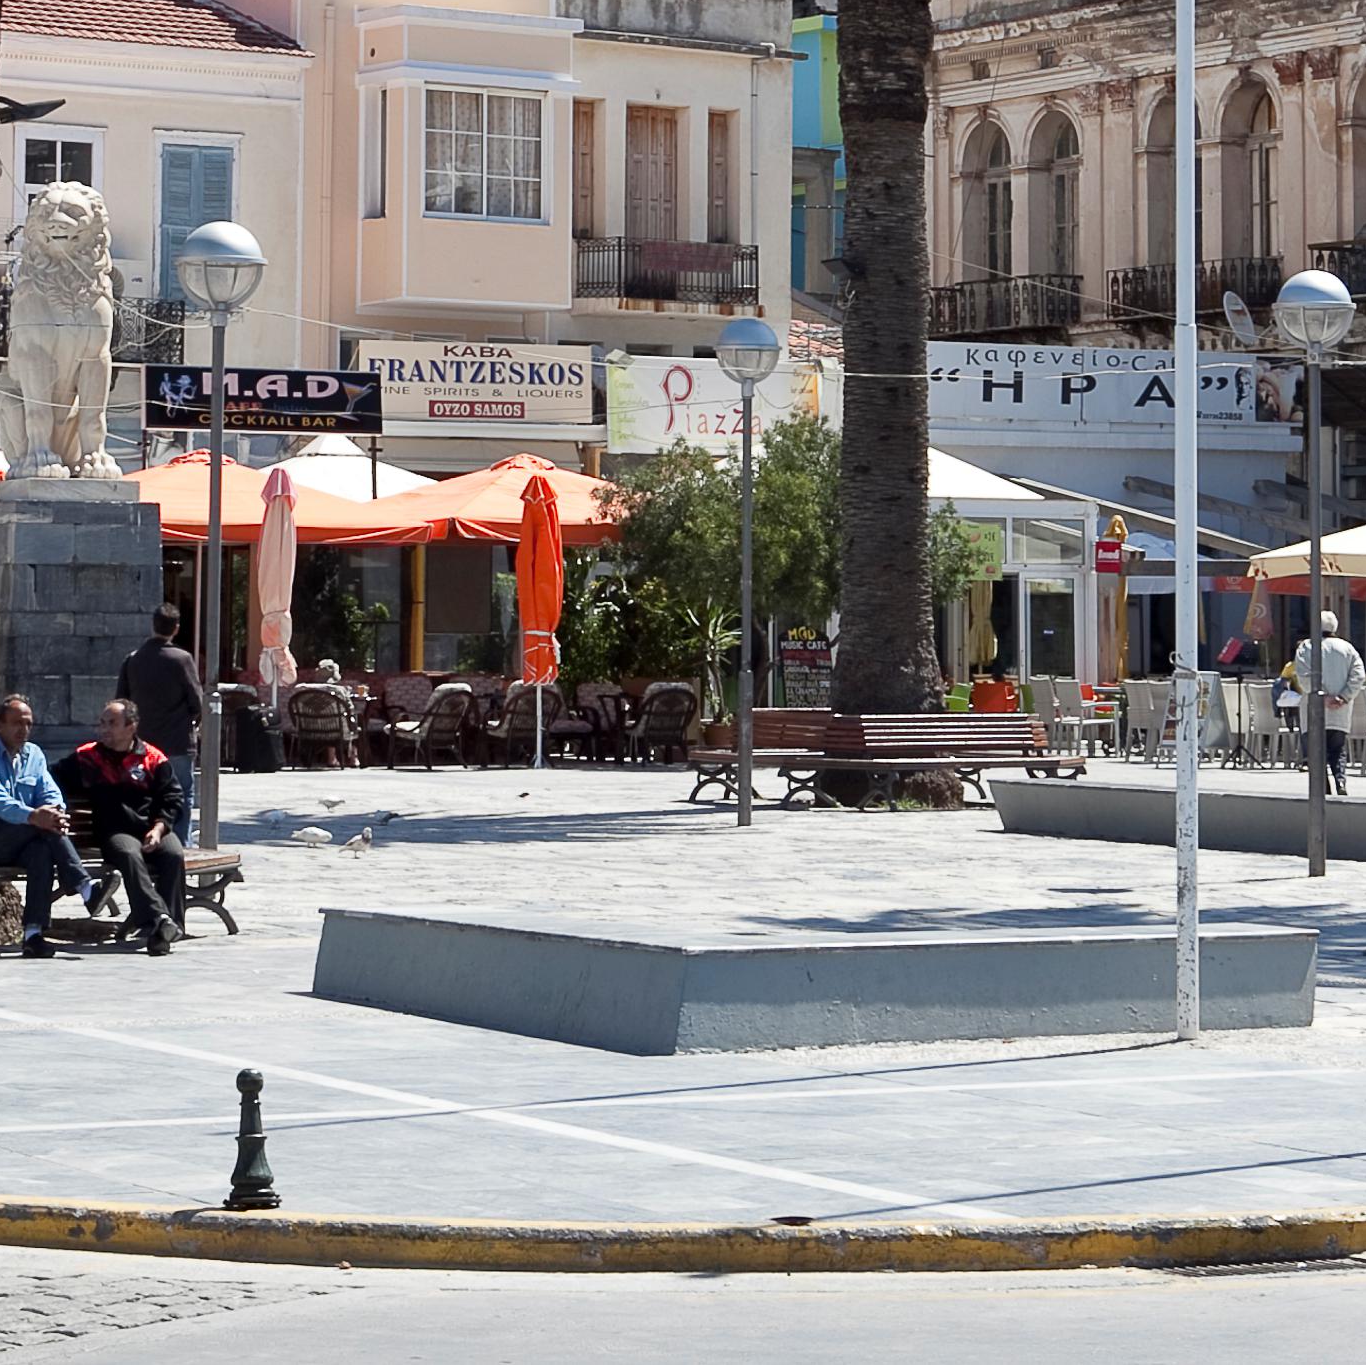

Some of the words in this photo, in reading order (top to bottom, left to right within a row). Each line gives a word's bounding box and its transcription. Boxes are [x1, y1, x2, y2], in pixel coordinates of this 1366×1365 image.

[368, 358, 585, 385] FRANTZESKOS
[381, 386, 411, 395] INE
[424, 387, 480, 397] SPIRITS
[492, 388, 503, 397] &
[301, 417, 337, 427] BAR
